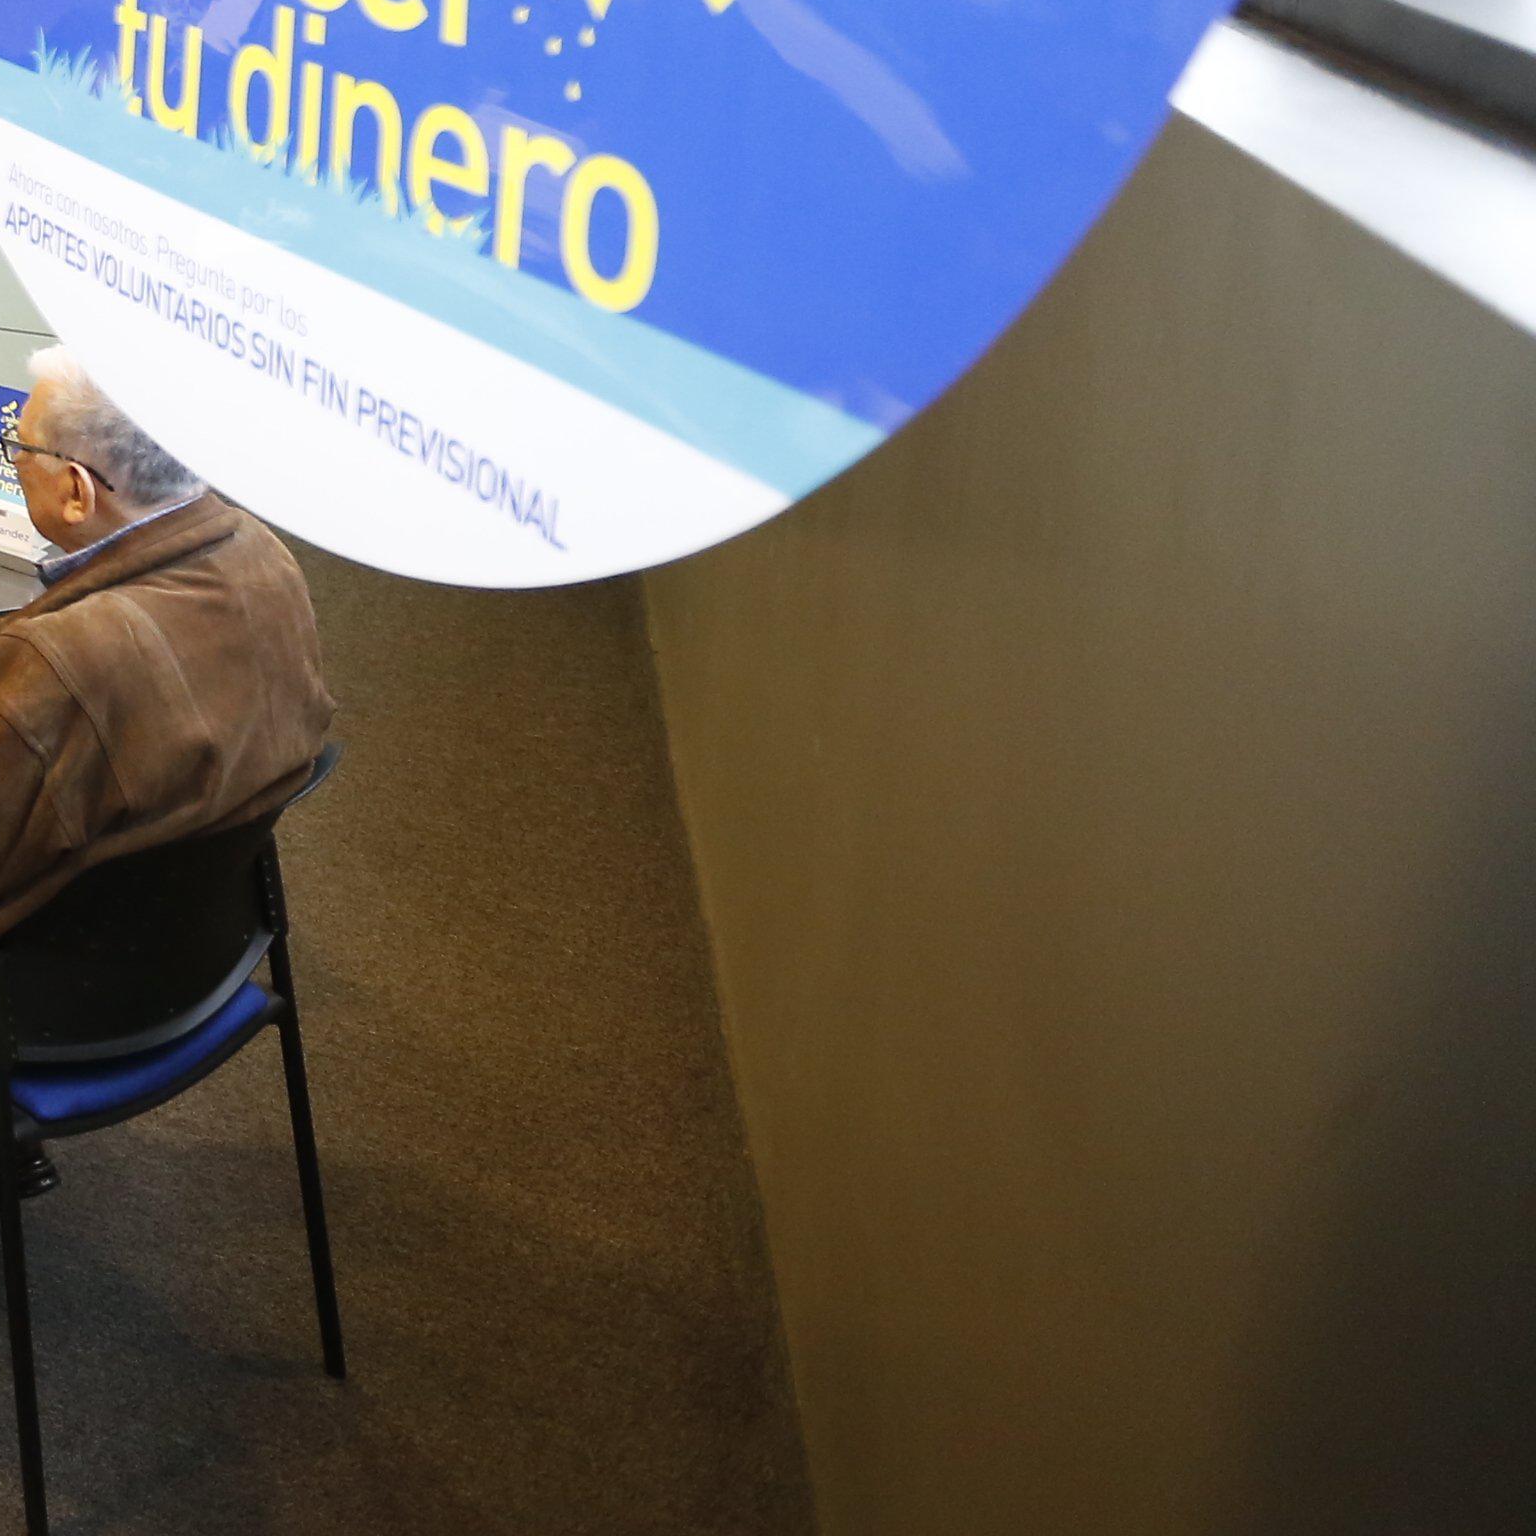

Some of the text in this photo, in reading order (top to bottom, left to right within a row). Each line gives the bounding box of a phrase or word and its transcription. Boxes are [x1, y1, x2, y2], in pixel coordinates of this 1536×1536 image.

[8, 163, 53, 206] Ahorra
[56, 190, 79, 216] con
[157, 234, 235, 300] Pregunta
[241, 284, 272, 316] por
[281, 295, 309, 338] los
[229, 4, 659, 313] dinero
[5, 202, 569, 553] APORTES VOLUNTARIOS SIN FIN PREVISIONAL
